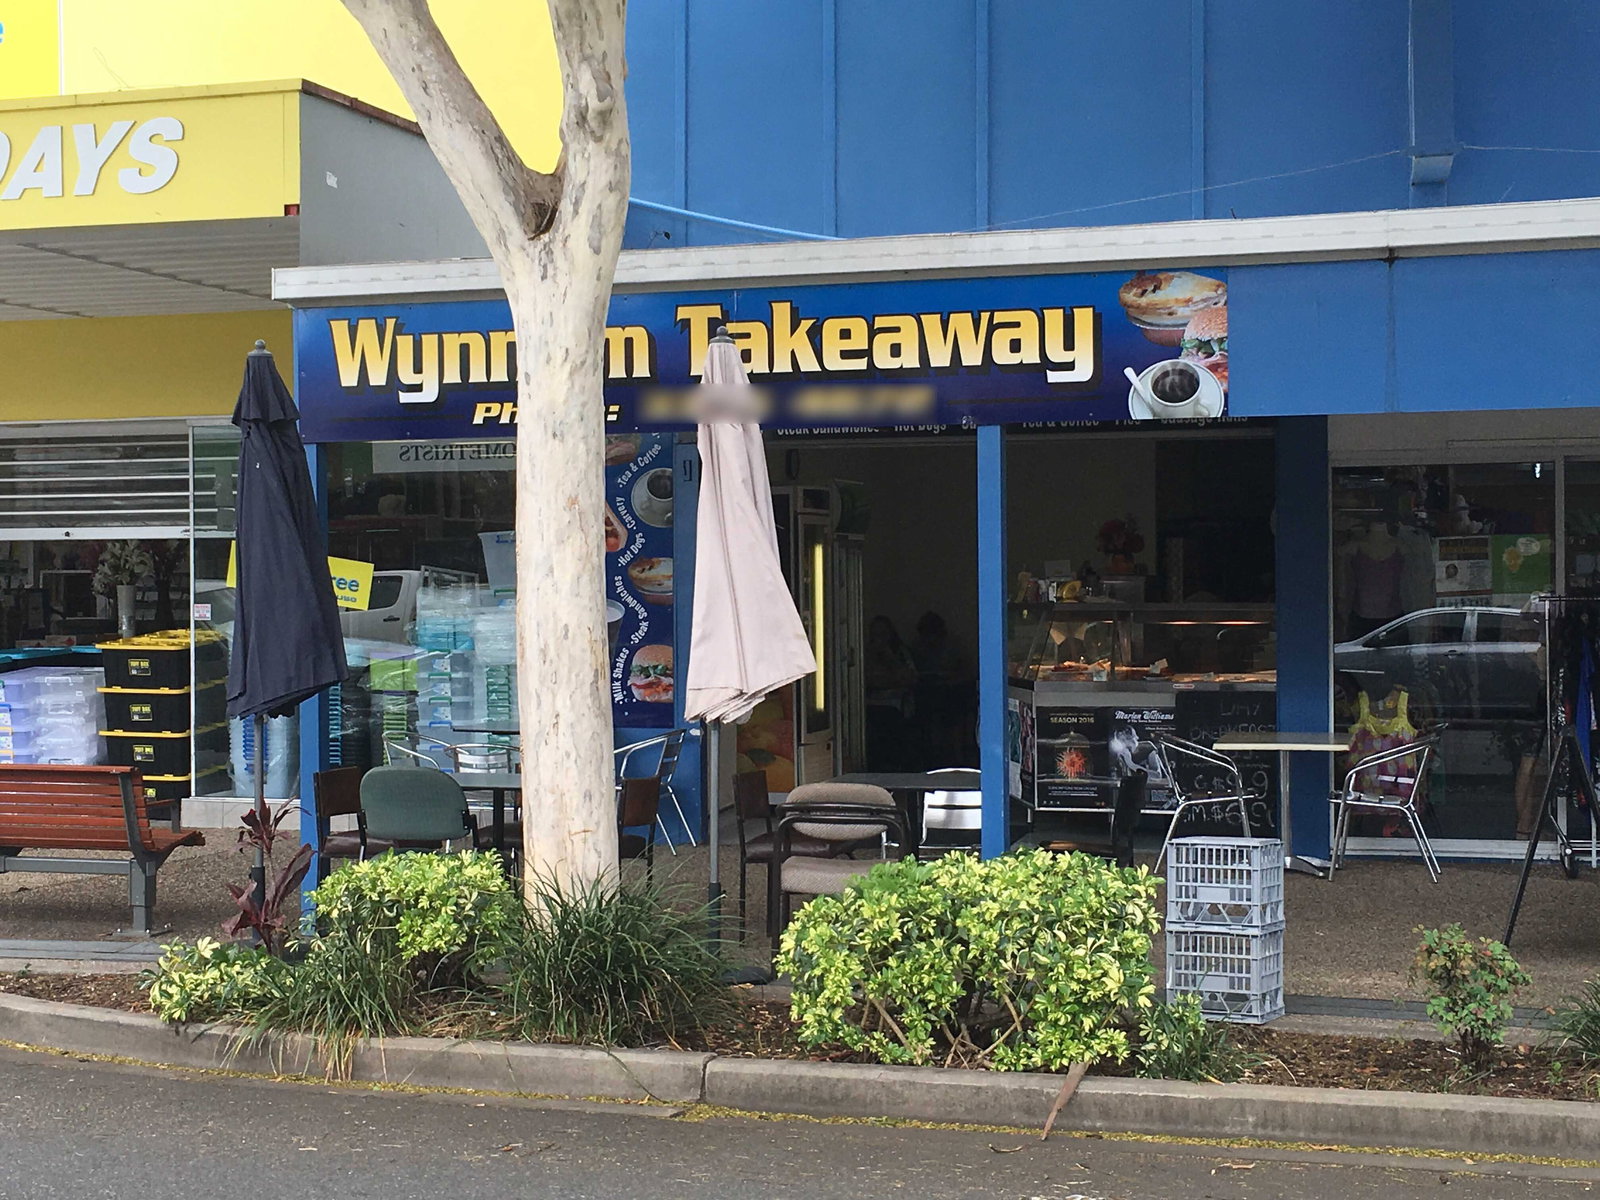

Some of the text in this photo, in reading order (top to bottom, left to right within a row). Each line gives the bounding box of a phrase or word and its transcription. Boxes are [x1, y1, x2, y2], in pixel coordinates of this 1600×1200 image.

[0, 116, 185, 200] AYS
[329, 316, 651, 404] Wynnm
[676, 300, 1096, 384] Takeaway
[617, 470, 632, 486] Tea
[637, 443, 662, 467] Coffee
[615, 496, 636, 529] Carvery
[618, 532, 646, 566] Hot Dogs
[614, 575, 649, 644] Steak Sandwiches
[611, 647, 630, 704] Milk Shakes
[1050, 716, 1078, 724] SEASON
